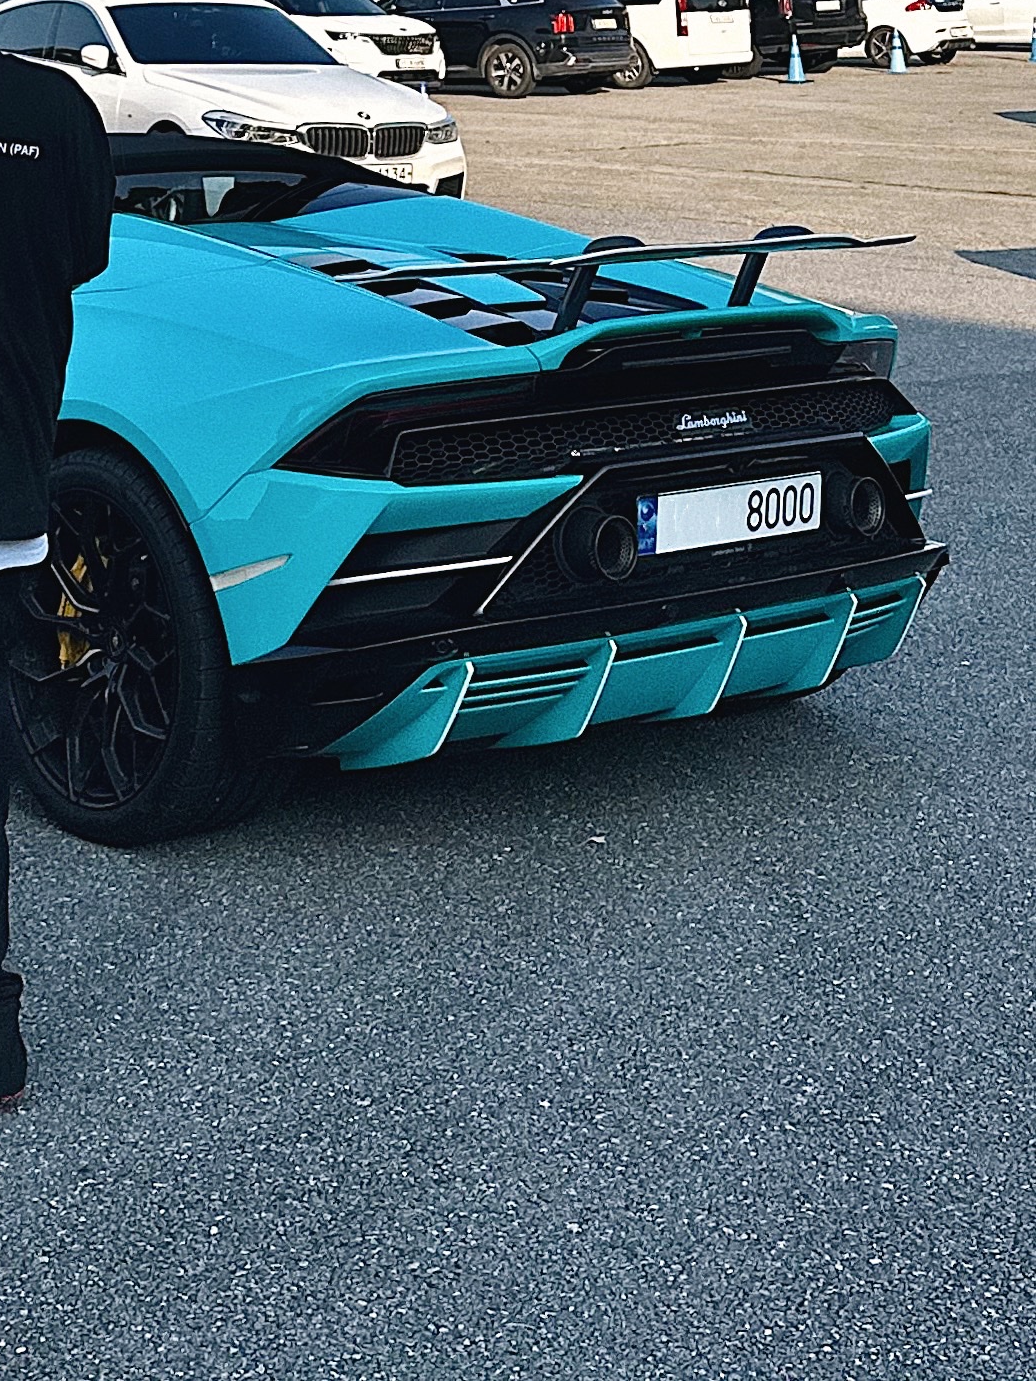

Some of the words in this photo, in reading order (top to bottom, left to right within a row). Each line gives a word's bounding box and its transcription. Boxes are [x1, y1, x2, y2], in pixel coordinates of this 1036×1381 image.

[9, 143, 40, 159] (PAF)
[676, 410, 748, 431] Lamborghini
[746, 482, 815, 532] 8000
